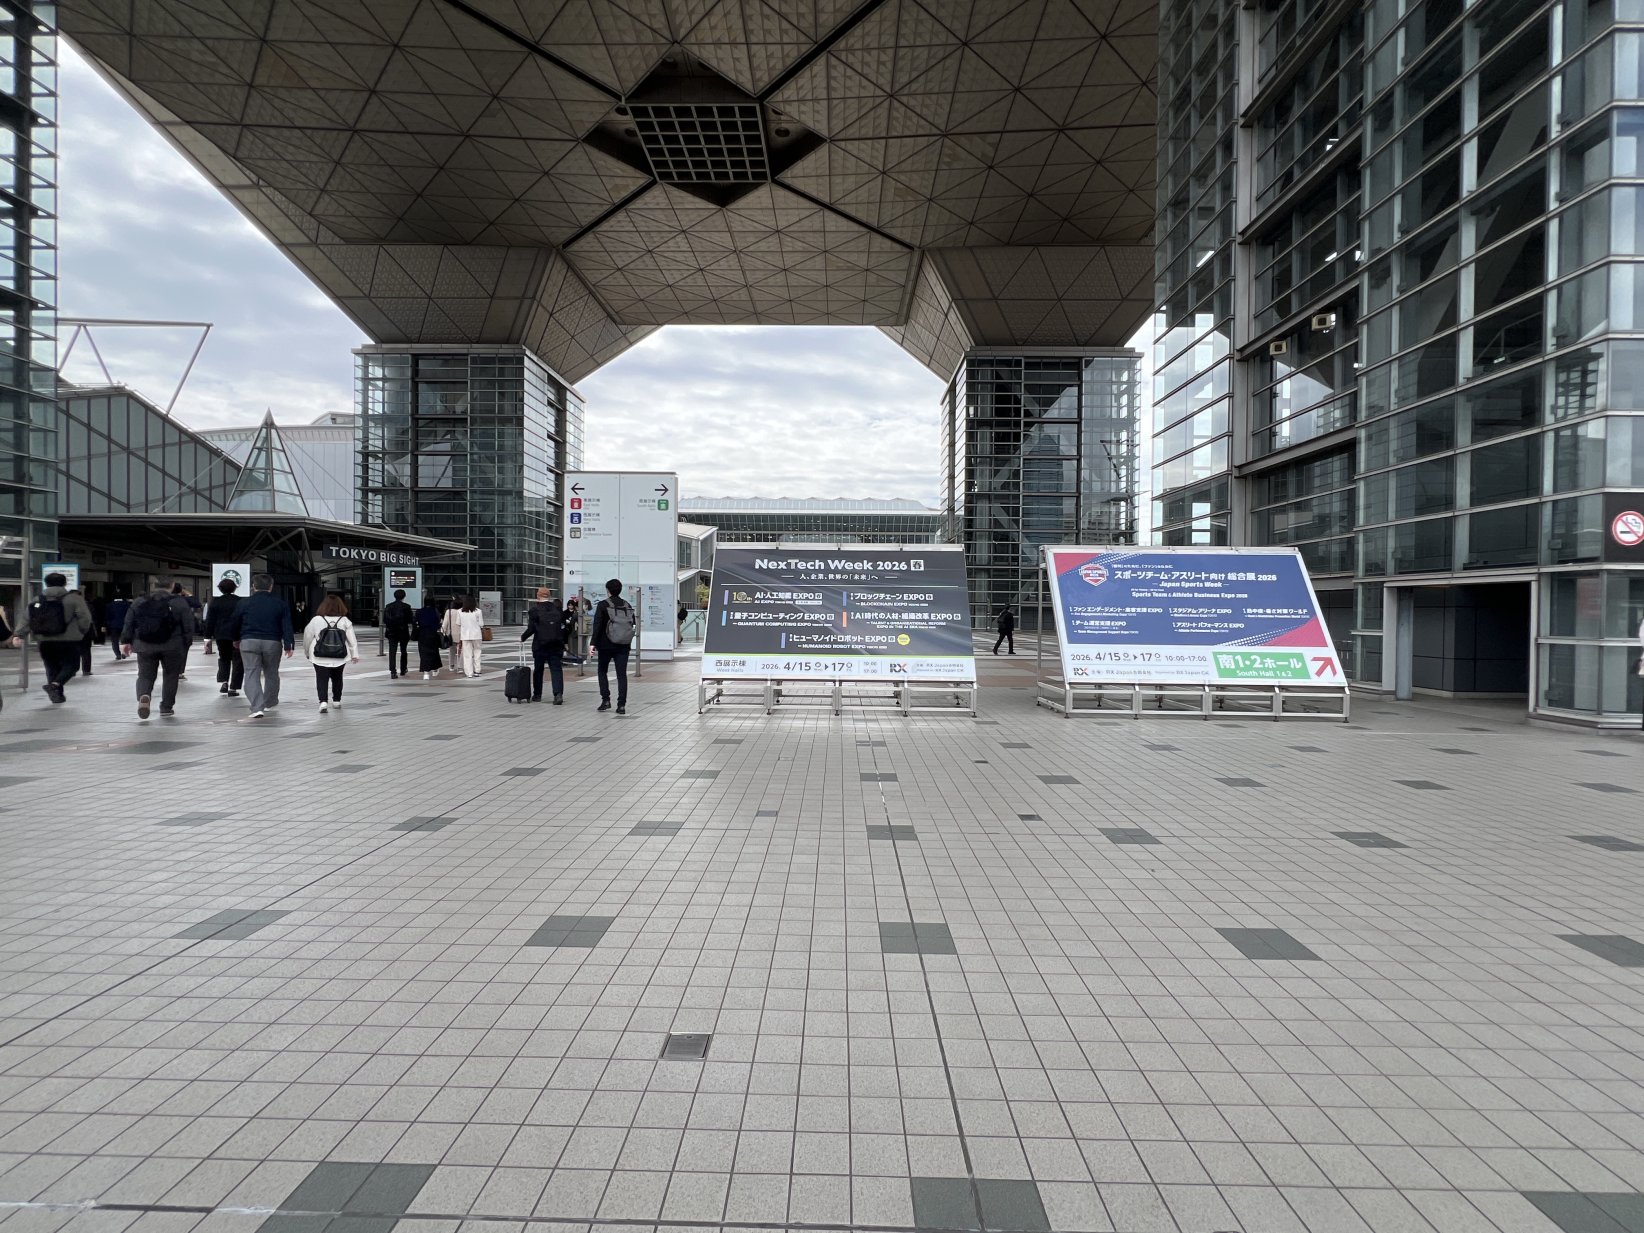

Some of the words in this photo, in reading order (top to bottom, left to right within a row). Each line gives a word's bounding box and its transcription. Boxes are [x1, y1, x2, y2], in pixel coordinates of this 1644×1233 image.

[330, 546, 376, 560] TOKYO
[380, 552, 396, 563] BIG
[398, 554, 419, 566] SIGHT
[754, 559, 824, 570] NexTech
[827, 560, 873, 570] Week
[876, 561, 907, 570] 2026
[1227, 572, 1256, 581] 総合展
[734, 612, 803, 620] 量子コンピューティング
[1095, 653, 1120, 661] 4/15
[1140, 653, 1152, 661] 17
[1216, 654, 1302, 669] 南1・2ホール
[715, 659, 746, 667] 西展示棟
[784, 662, 811, 671] 4/15
[832, 662, 845, 671] 17
[890, 663, 908, 673] RX
[1073, 667, 1089, 676] RX
